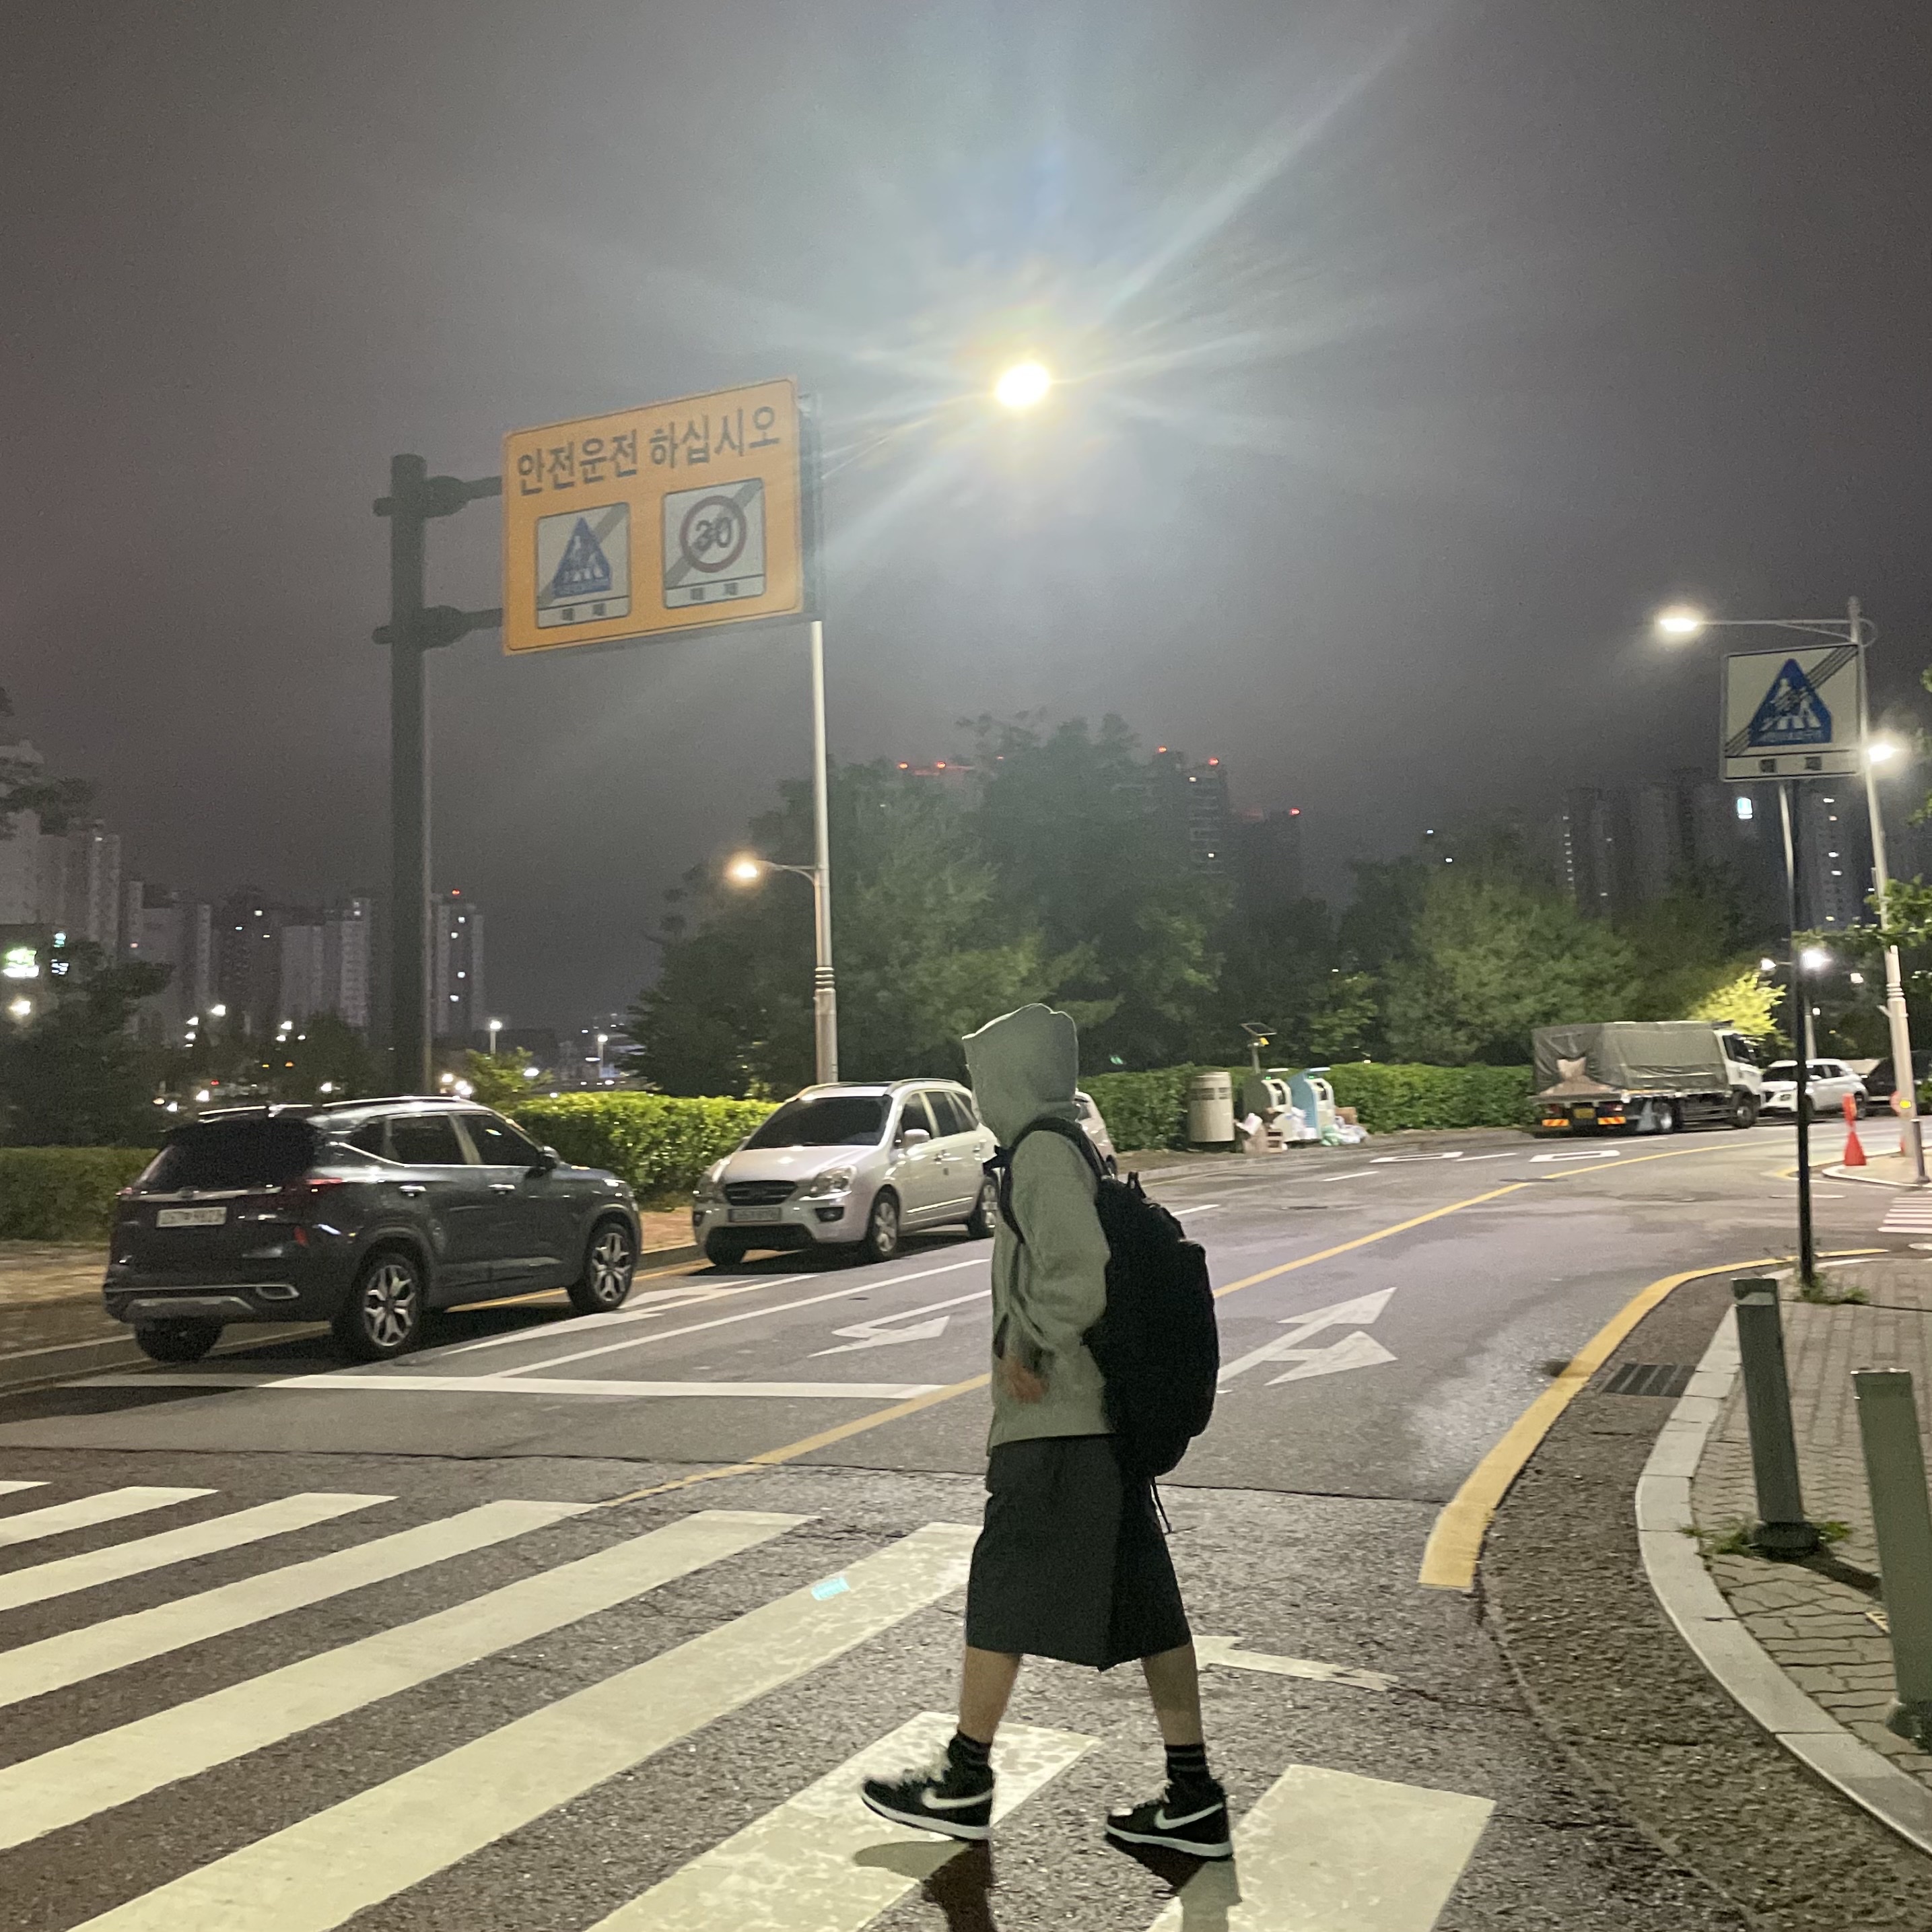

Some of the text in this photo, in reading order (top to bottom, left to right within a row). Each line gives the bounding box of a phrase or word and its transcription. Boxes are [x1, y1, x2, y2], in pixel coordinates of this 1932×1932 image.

[517, 406, 780, 496] 안전운전 하십시오
[694, 516, 732, 552] 30
